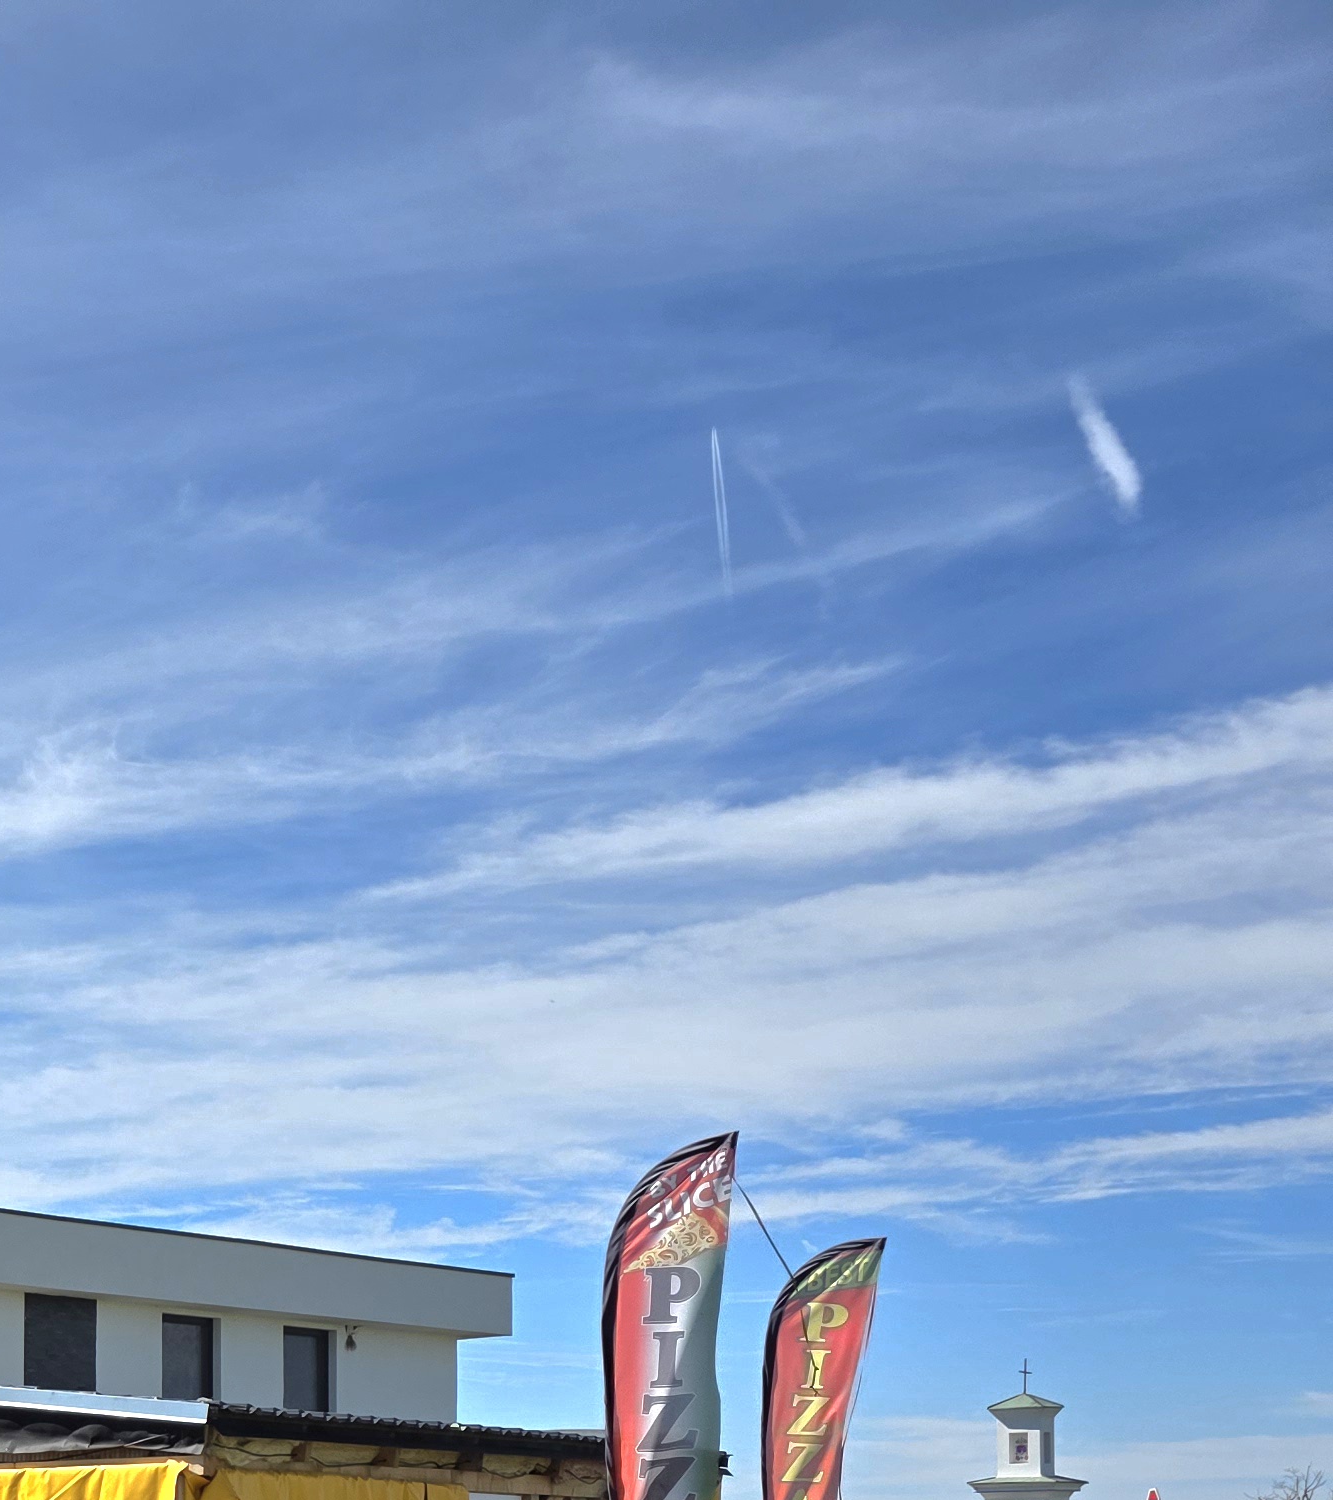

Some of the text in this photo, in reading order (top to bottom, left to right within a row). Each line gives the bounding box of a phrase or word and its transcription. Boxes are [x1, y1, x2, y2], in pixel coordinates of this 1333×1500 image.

[650, 1151, 728, 1198] BY THE
[647, 1174, 732, 1228] SLICE
[807, 1257, 869, 1291] BEST
